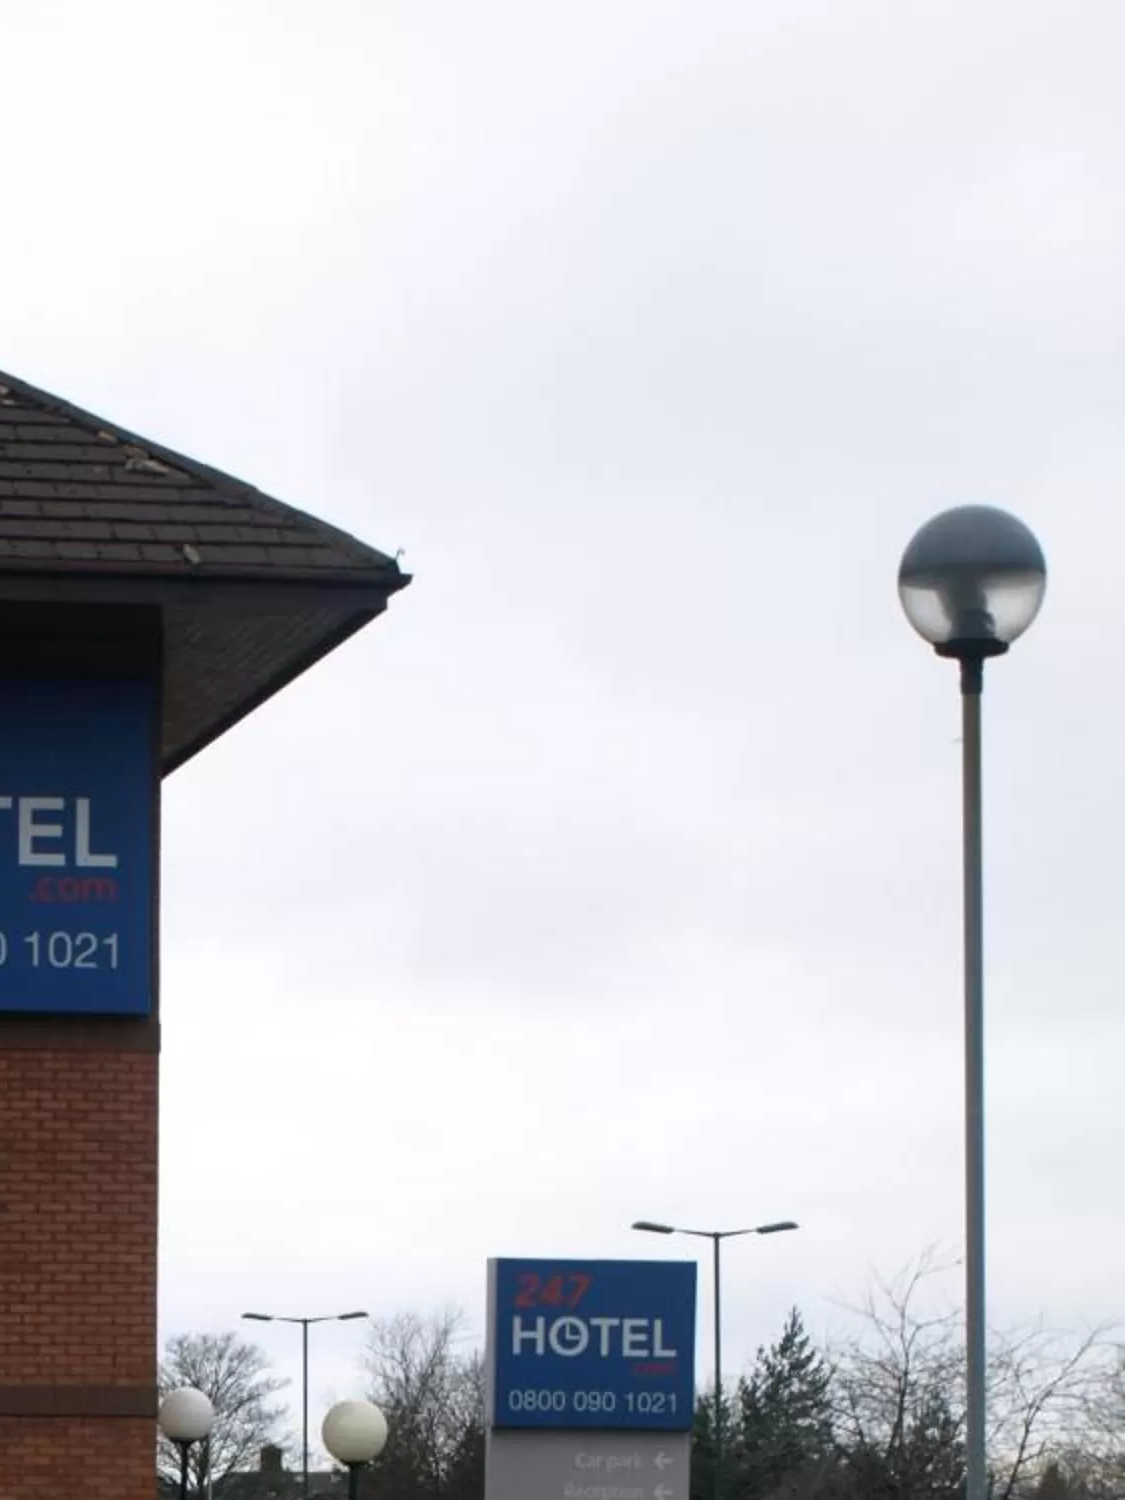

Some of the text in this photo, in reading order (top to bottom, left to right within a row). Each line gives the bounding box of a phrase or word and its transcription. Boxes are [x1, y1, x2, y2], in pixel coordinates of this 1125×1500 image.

[23, 931, 119, 970] 1021
[514, 1272, 592, 1309] 247
[511, 1315, 678, 1357] HOTEL
[508, 1389, 677, 1415] 0800 090 1021
